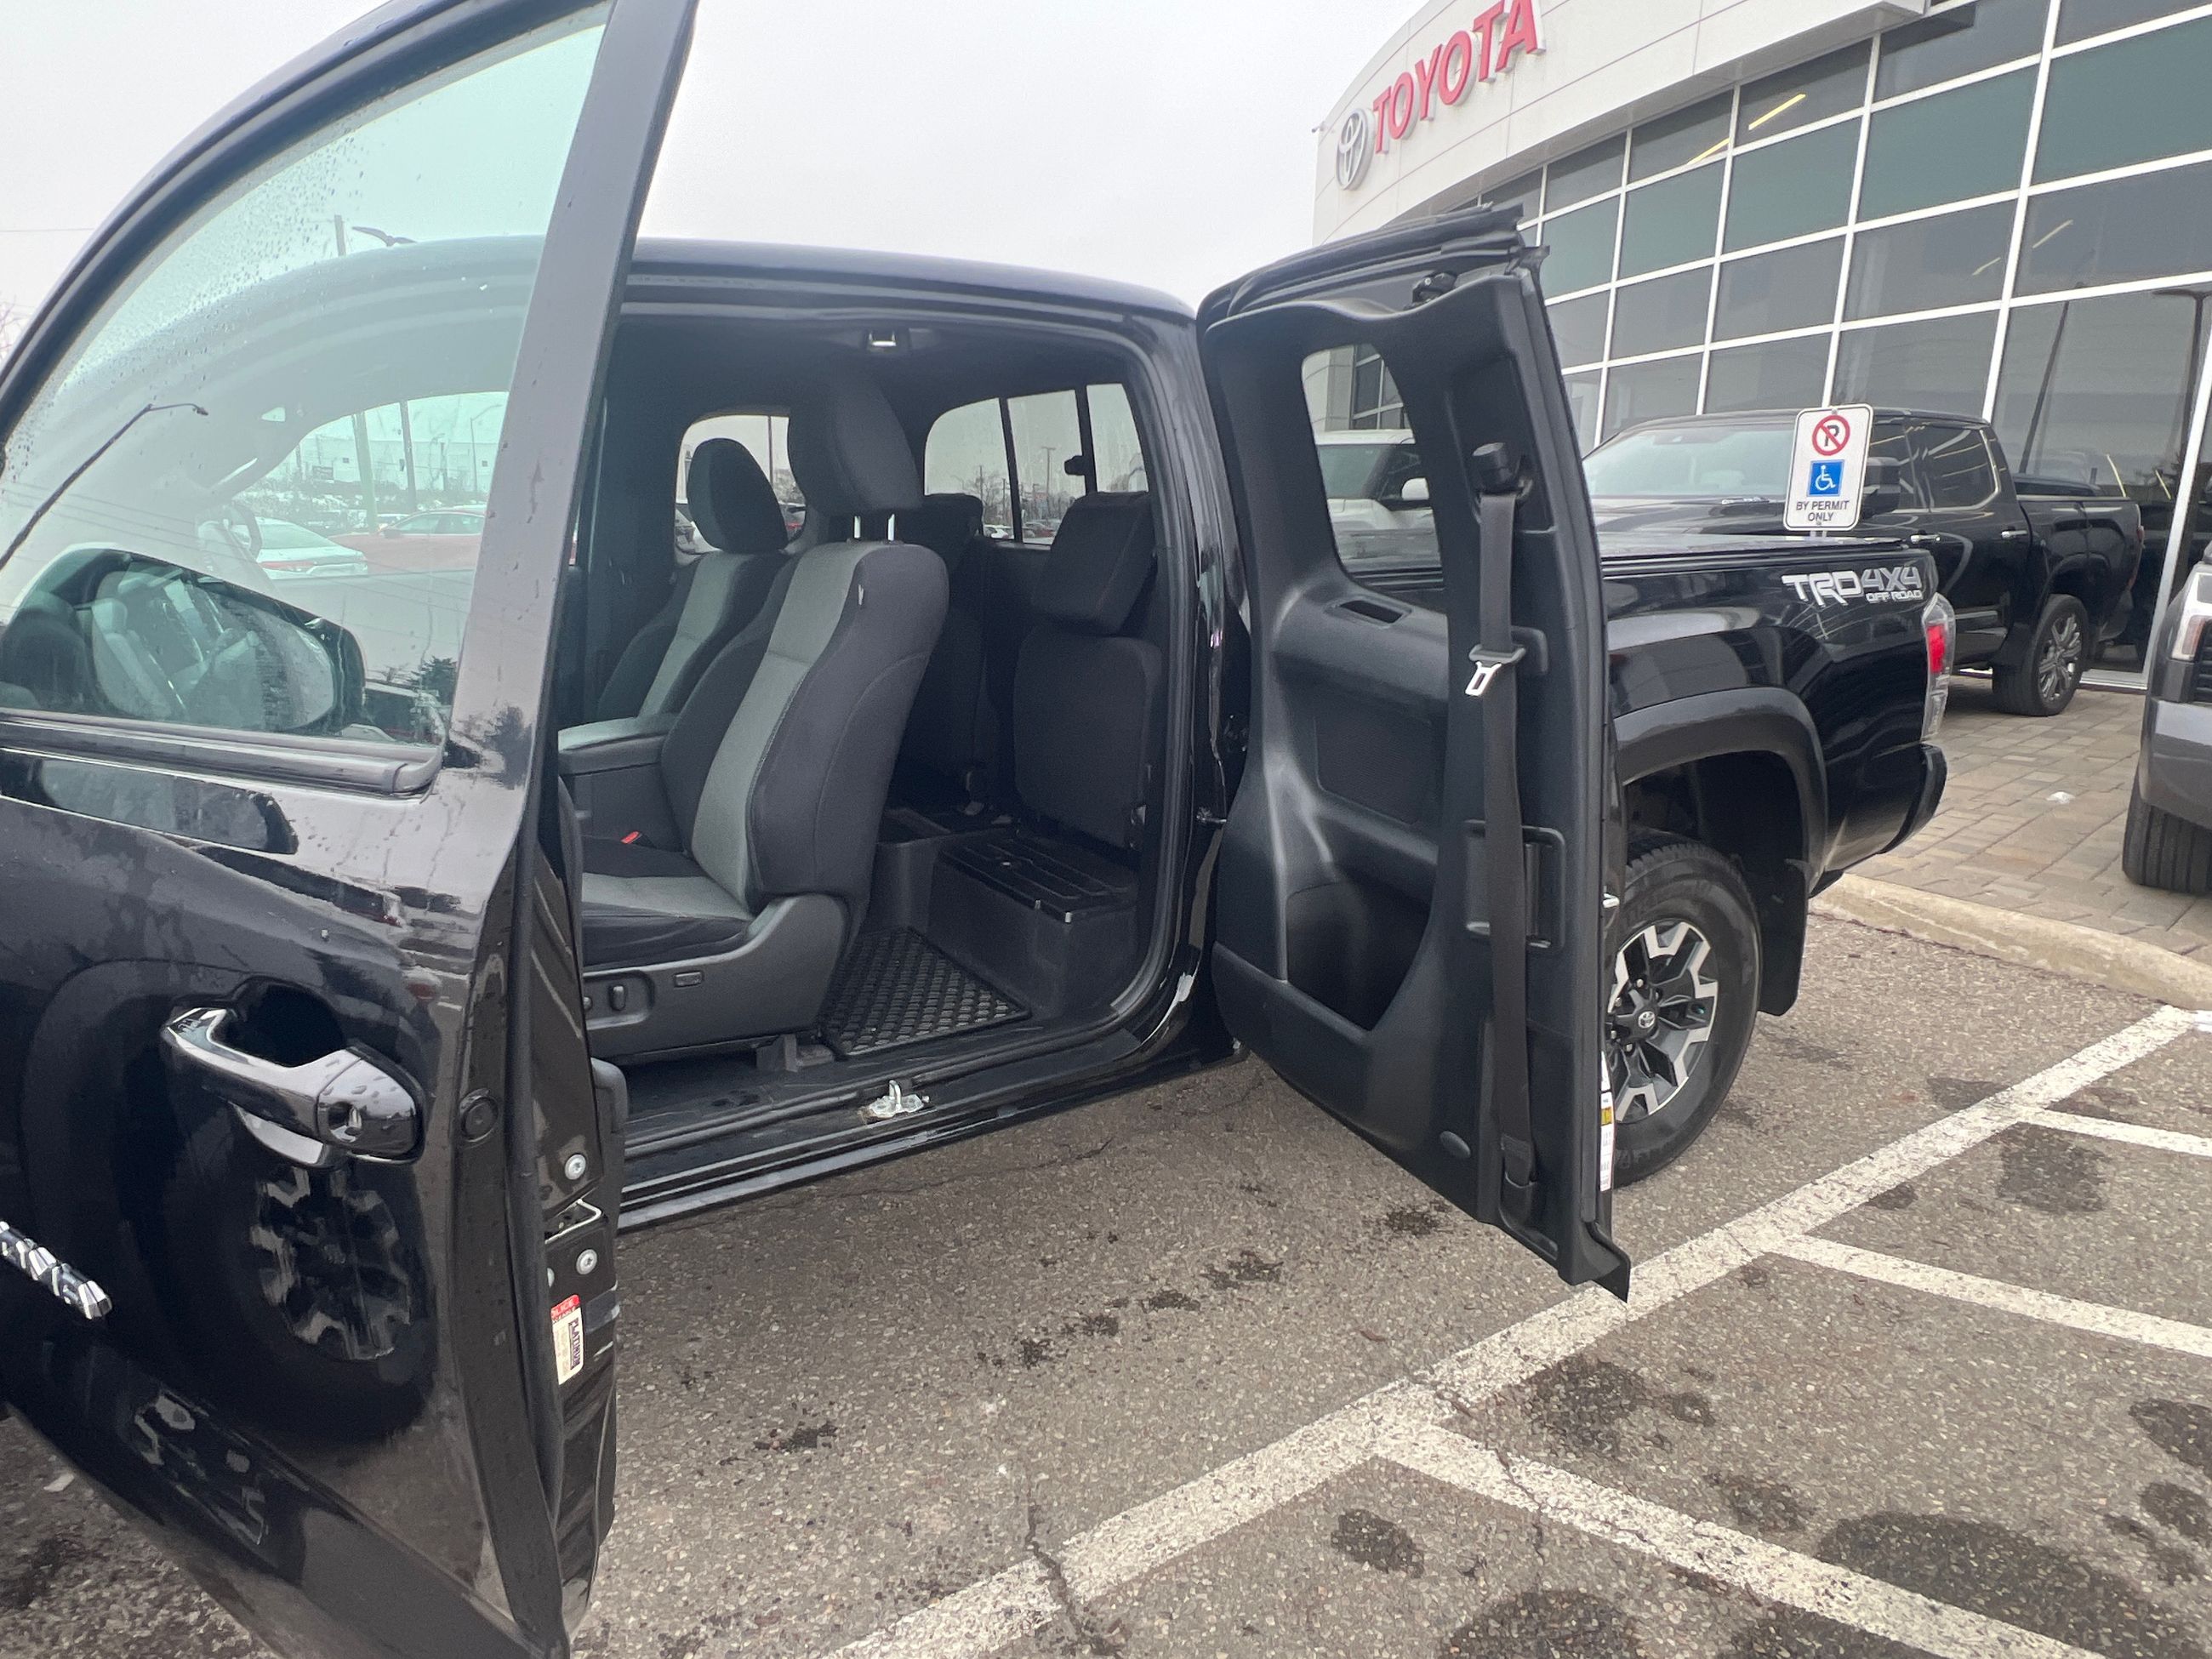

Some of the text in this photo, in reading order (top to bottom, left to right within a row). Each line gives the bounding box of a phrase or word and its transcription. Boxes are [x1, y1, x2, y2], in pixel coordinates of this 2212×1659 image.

[1371, 0, 1543, 154] TOYOTA
[1824, 425, 1839, 447] P
[1796, 500, 1850, 510] BY PERMIT
[1808, 512, 1833, 522] ONLY
[1782, 570, 1863, 607] TRD
[1866, 590, 1923, 603] OFF ROAD
